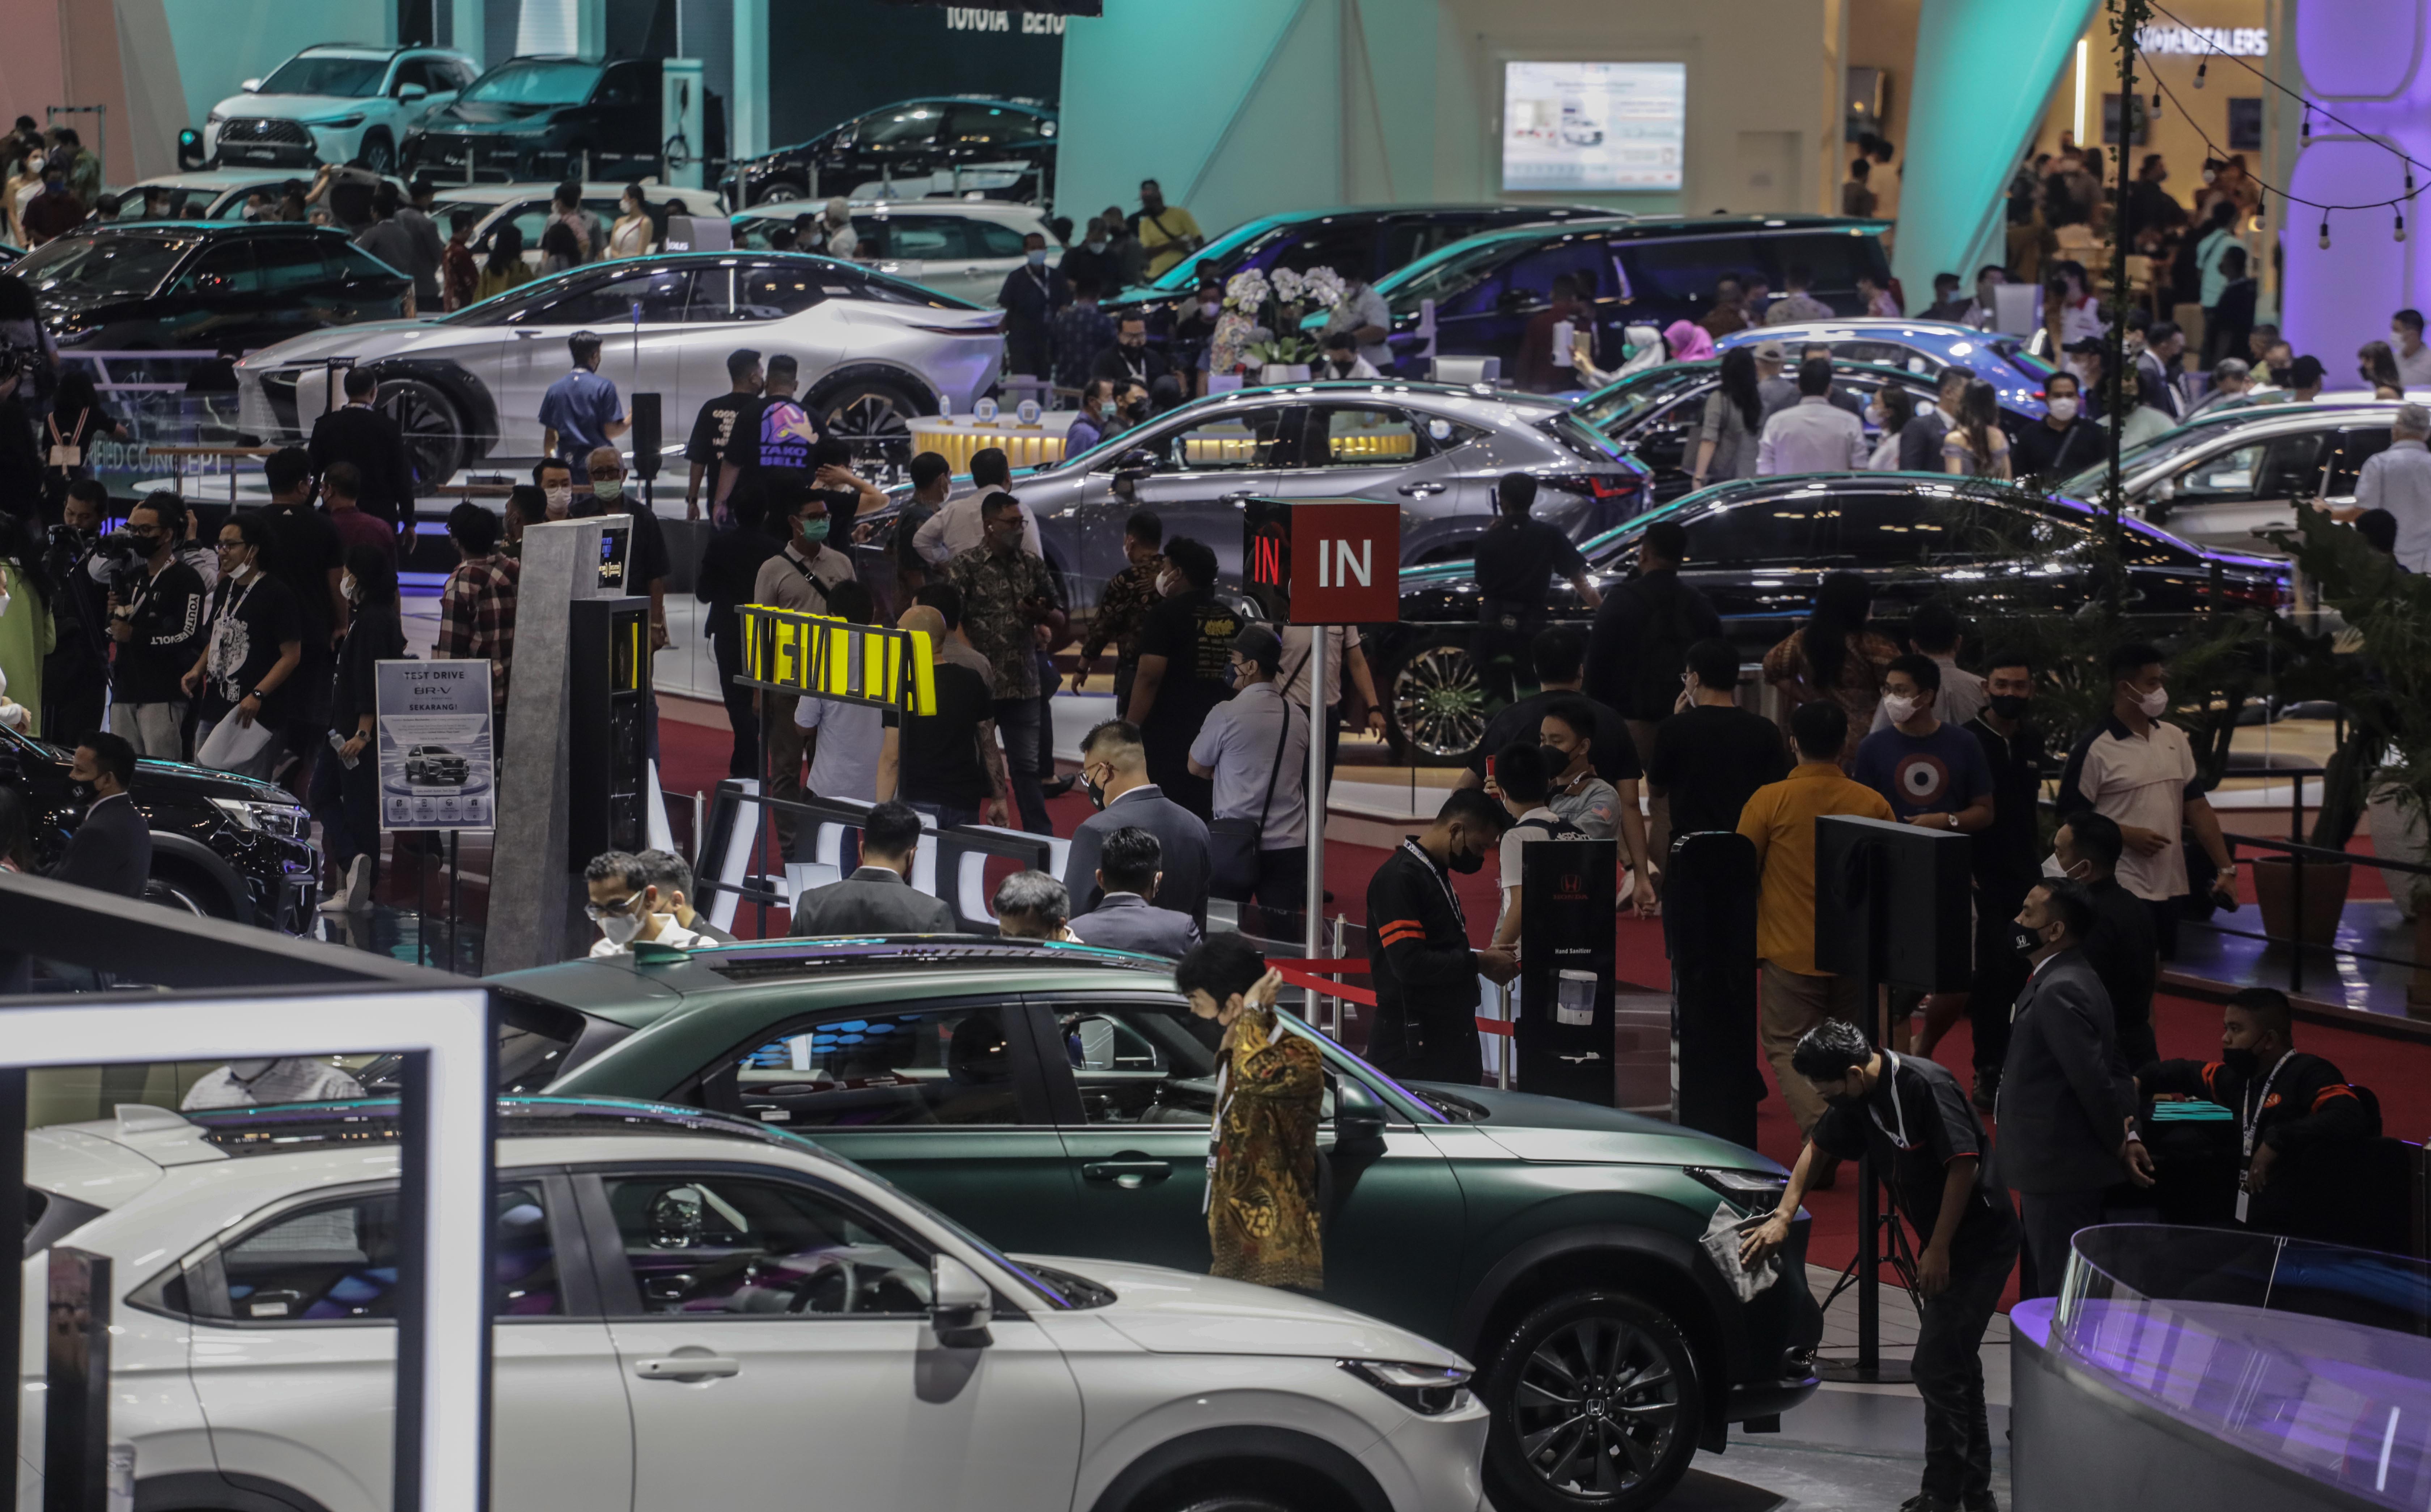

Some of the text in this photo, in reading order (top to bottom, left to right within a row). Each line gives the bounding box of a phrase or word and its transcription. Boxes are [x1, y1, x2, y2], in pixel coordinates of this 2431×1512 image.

[760, 446, 807, 457] TAKO
[760, 456, 807, 468] BELL
[1255, 535, 1279, 585] IN
[1319, 539, 1371, 587] IN
[150, 596, 198, 645] YOUTH REVOLT
